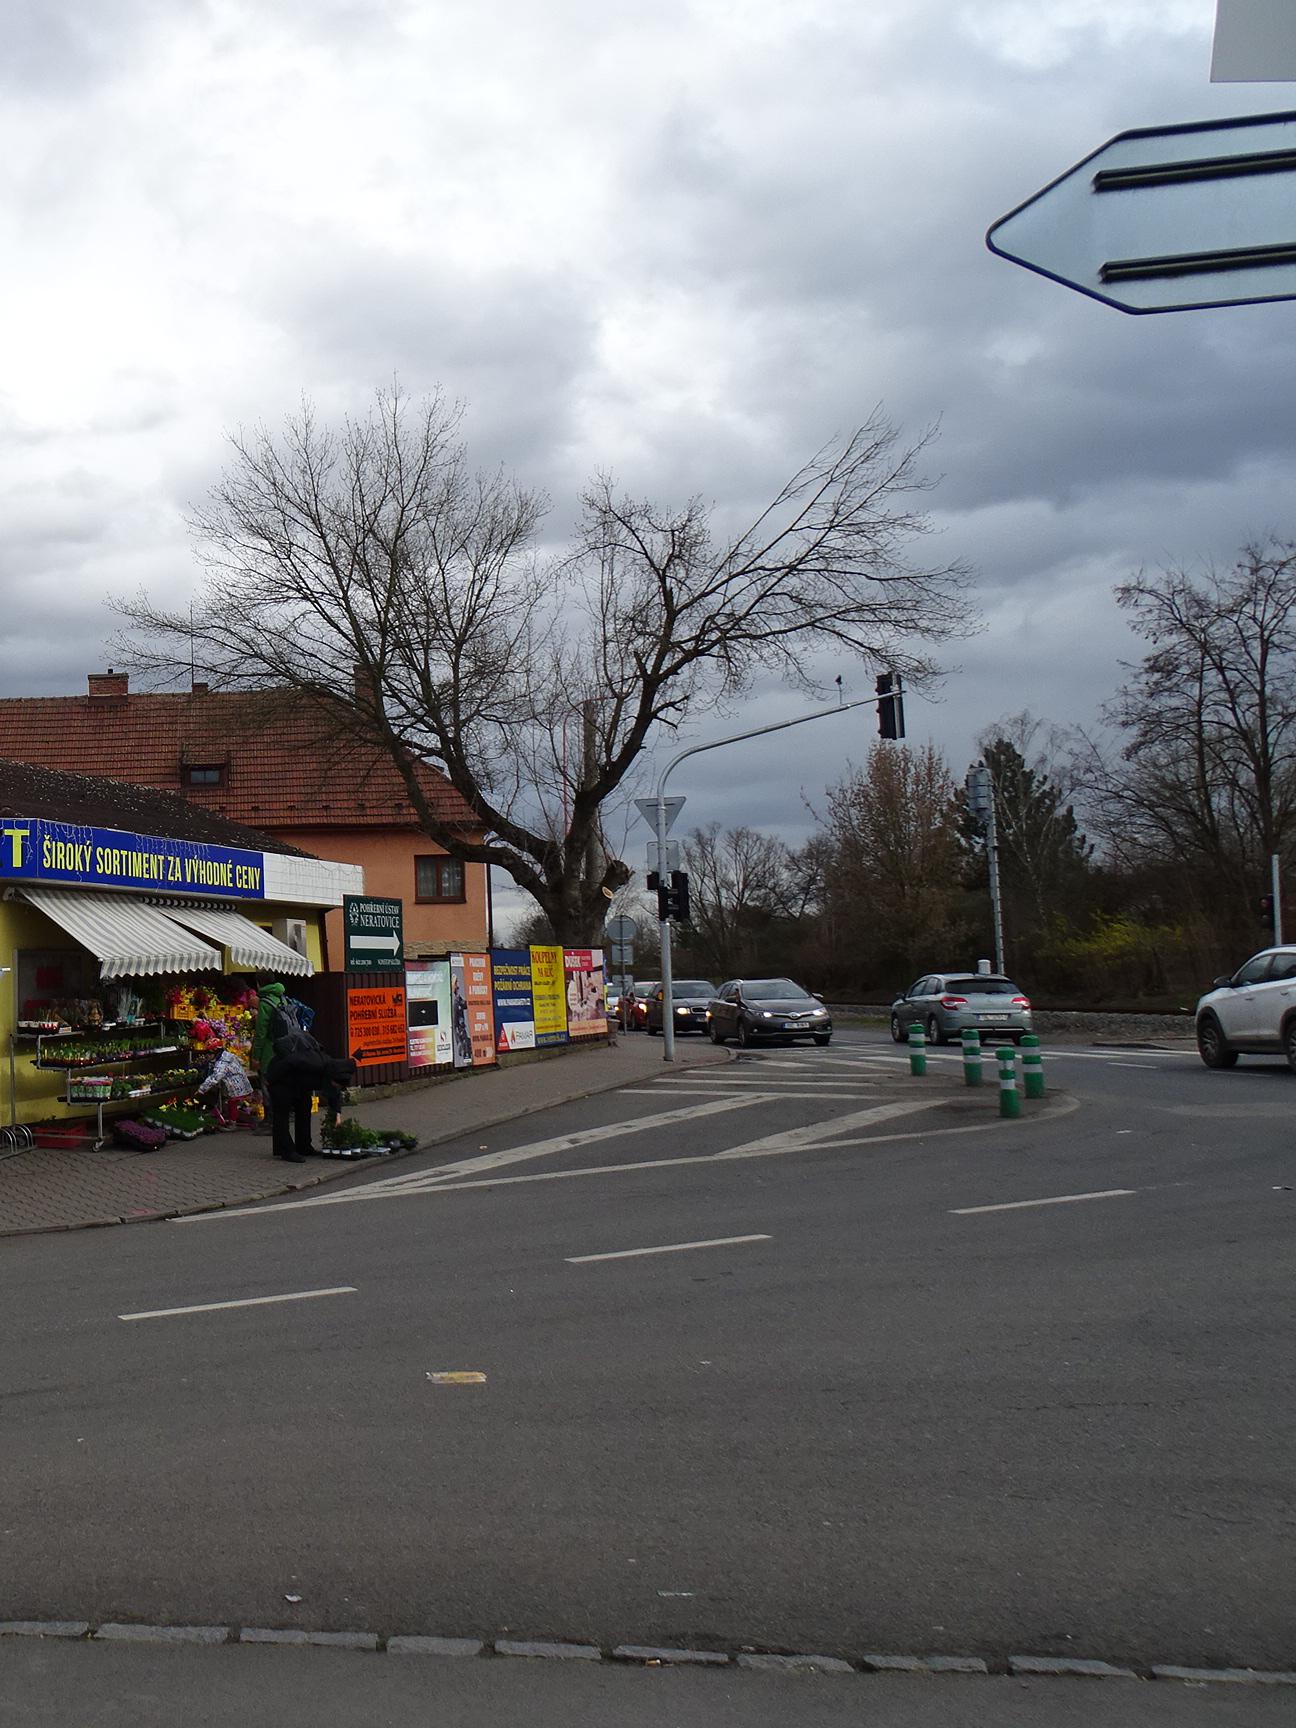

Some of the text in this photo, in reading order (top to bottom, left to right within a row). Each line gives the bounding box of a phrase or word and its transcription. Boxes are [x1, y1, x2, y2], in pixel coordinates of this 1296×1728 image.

[42, 834, 261, 890] ŠIROKÝ SORTIMENT ZA VÝHODNÉ CENY
[360, 914, 400, 928] NERATOVICE
[349, 993, 386, 1006] NERATOVICKÁ
